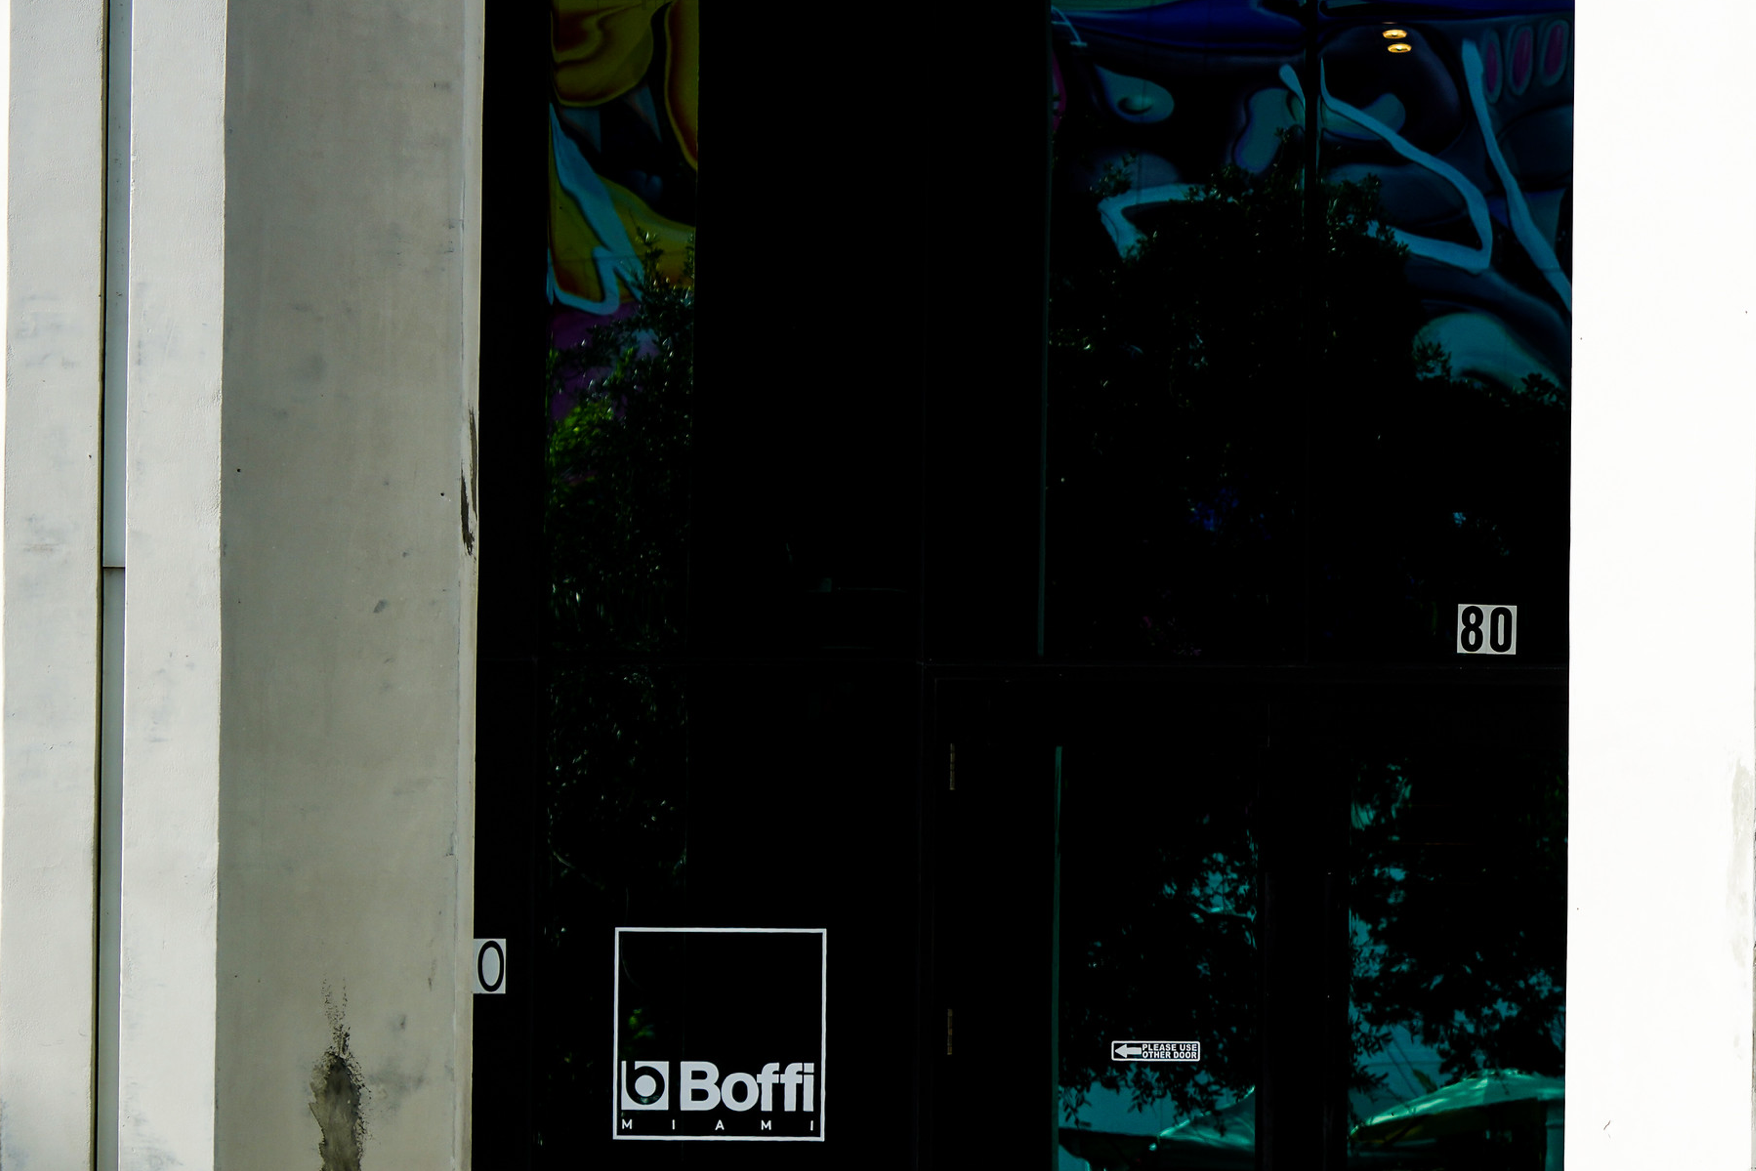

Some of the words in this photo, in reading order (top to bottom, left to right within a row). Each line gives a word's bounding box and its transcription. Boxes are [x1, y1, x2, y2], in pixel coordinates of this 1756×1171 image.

[1460, 605, 1513, 653] 80
[477, 940, 505, 993] 0
[1142, 1043, 1177, 1051] PLEASE
[1179, 1043, 1198, 1051] USE
[1142, 1051, 1171, 1059] OTHER
[1173, 1051, 1197, 1059] DOOR
[680, 1060, 814, 1112] Boffi
